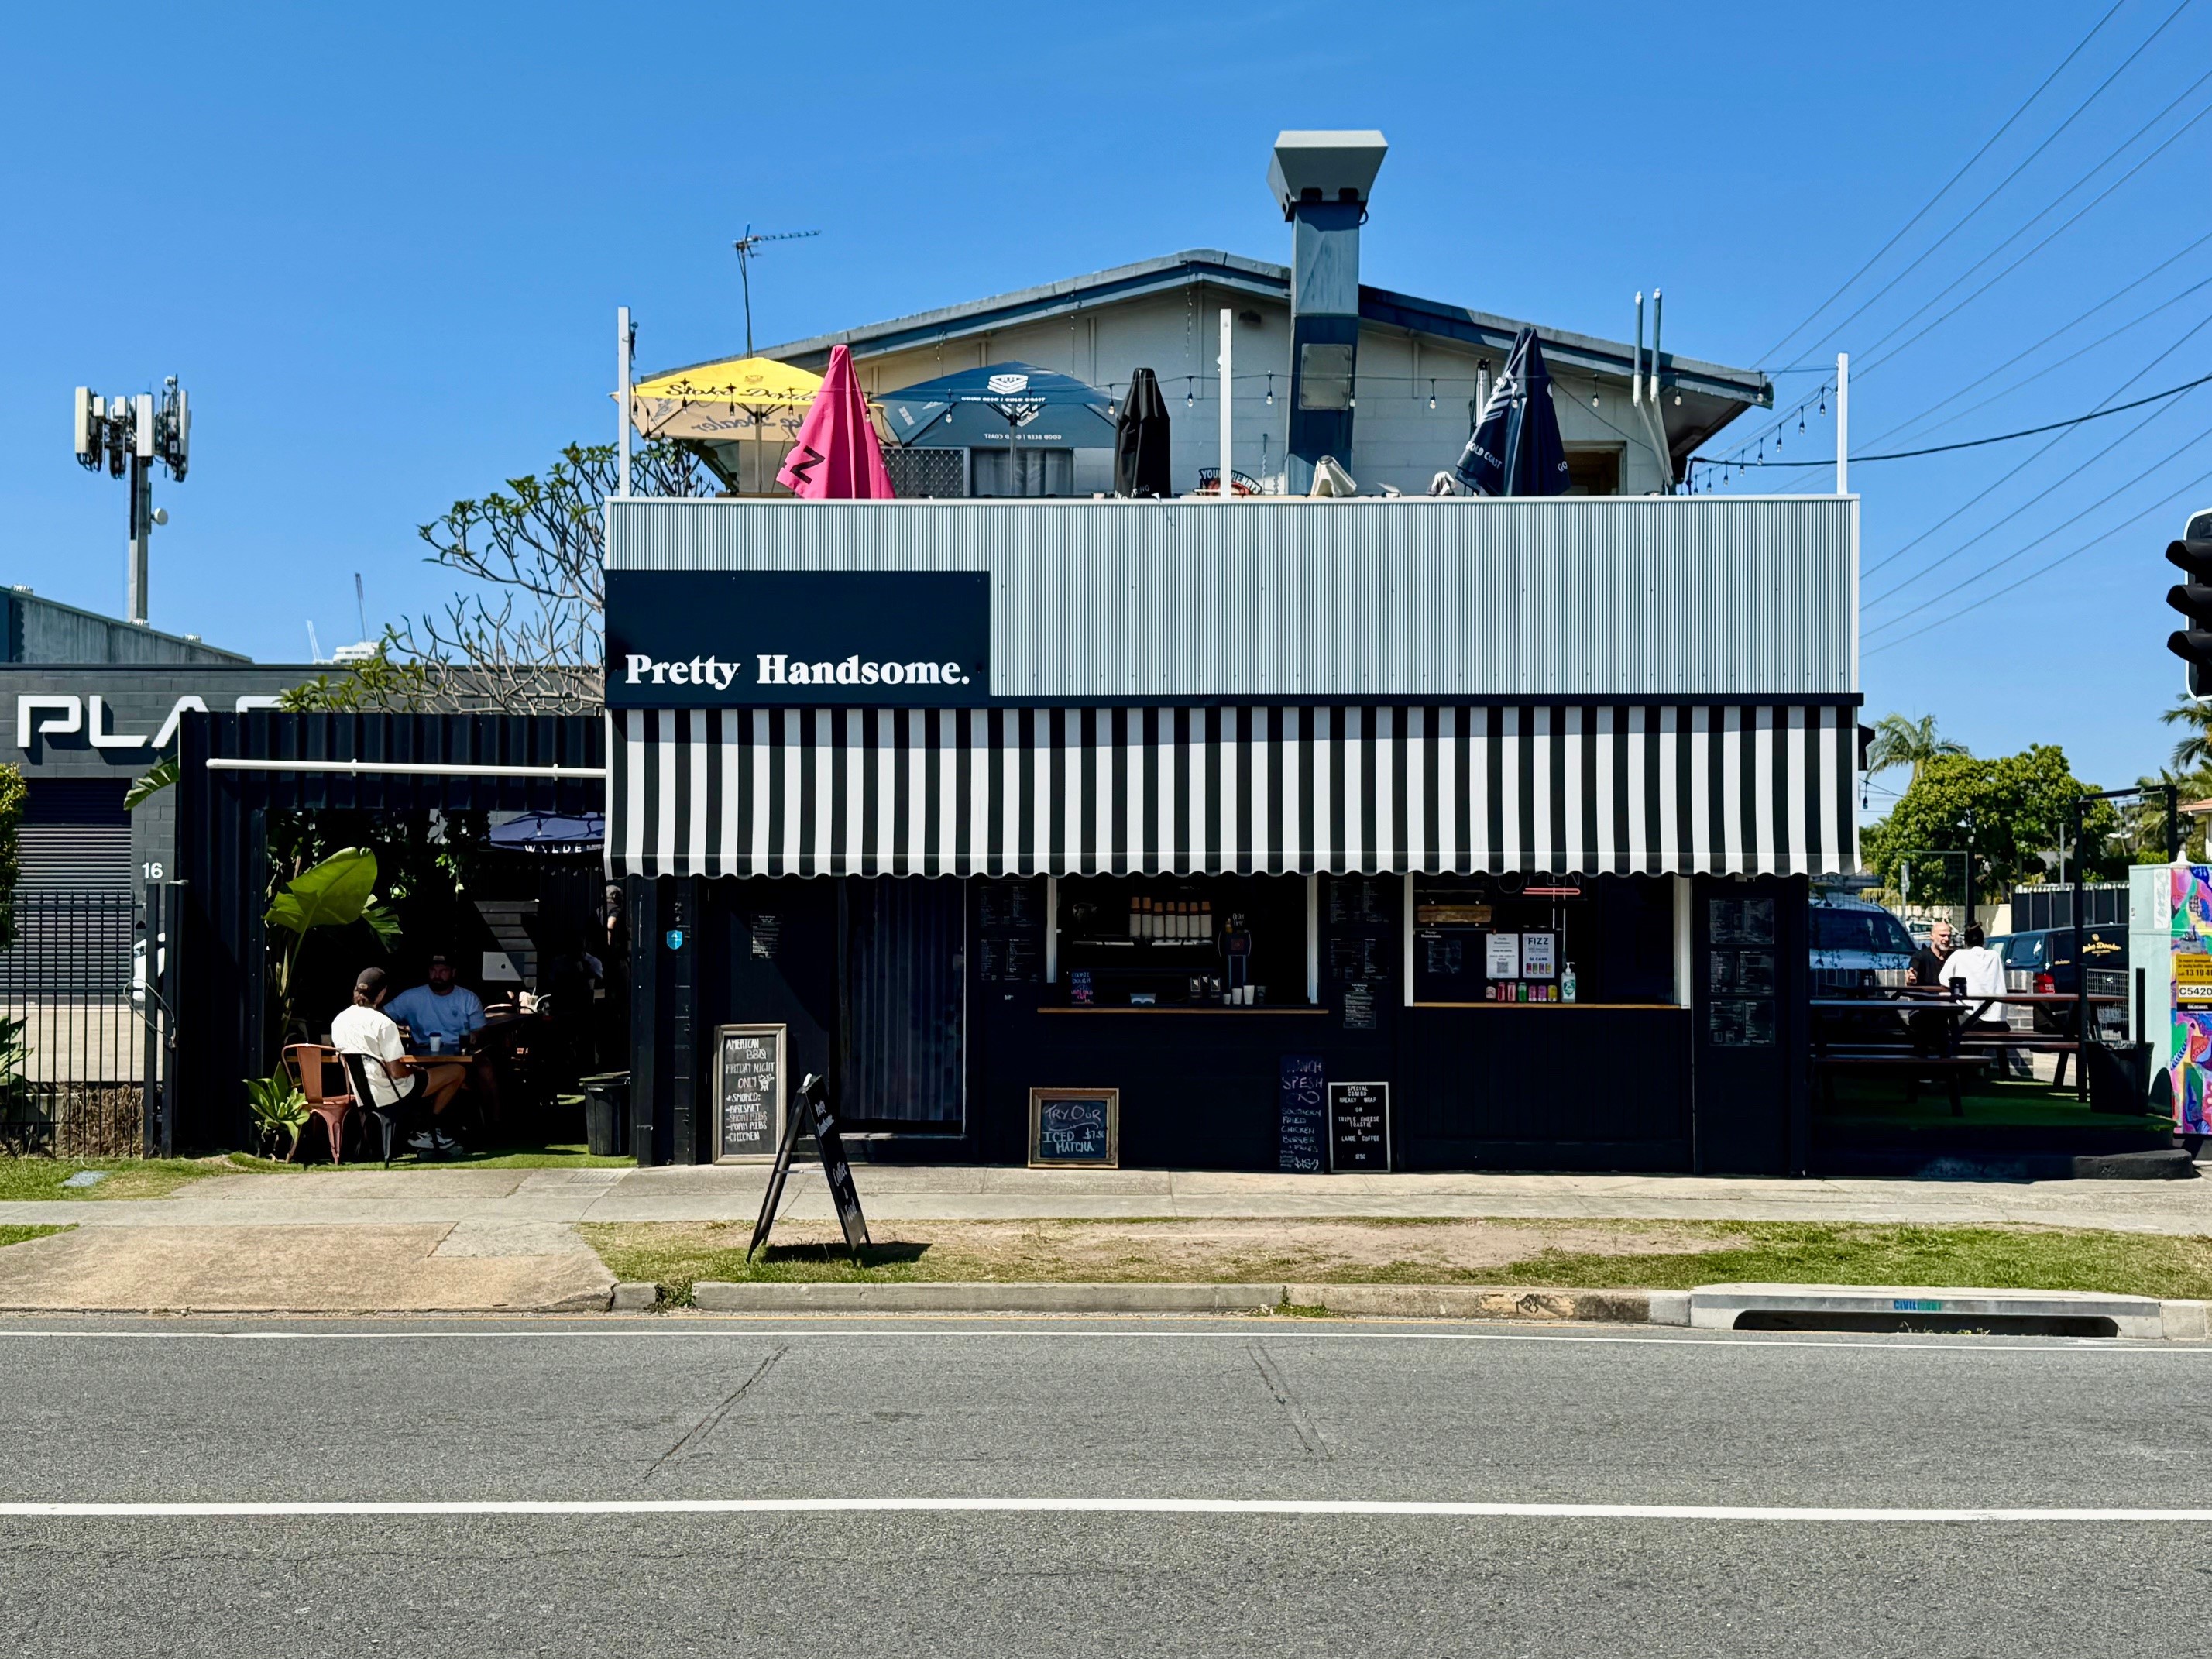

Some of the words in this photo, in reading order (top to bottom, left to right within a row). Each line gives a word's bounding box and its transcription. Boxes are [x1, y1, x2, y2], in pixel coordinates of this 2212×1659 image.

[624, 654, 741, 691] Pretty
[756, 654, 970, 685] Handsome.
[142, 862, 163, 879] 16
[726, 1039, 759, 1049] AMERICAN
[1046, 1104, 1069, 1120] TRY
[1280, 1125, 1315, 1135] CHICKEN
[1042, 1131, 1075, 1143] ICED
[1056, 1141, 1094, 1154] MATCHA
